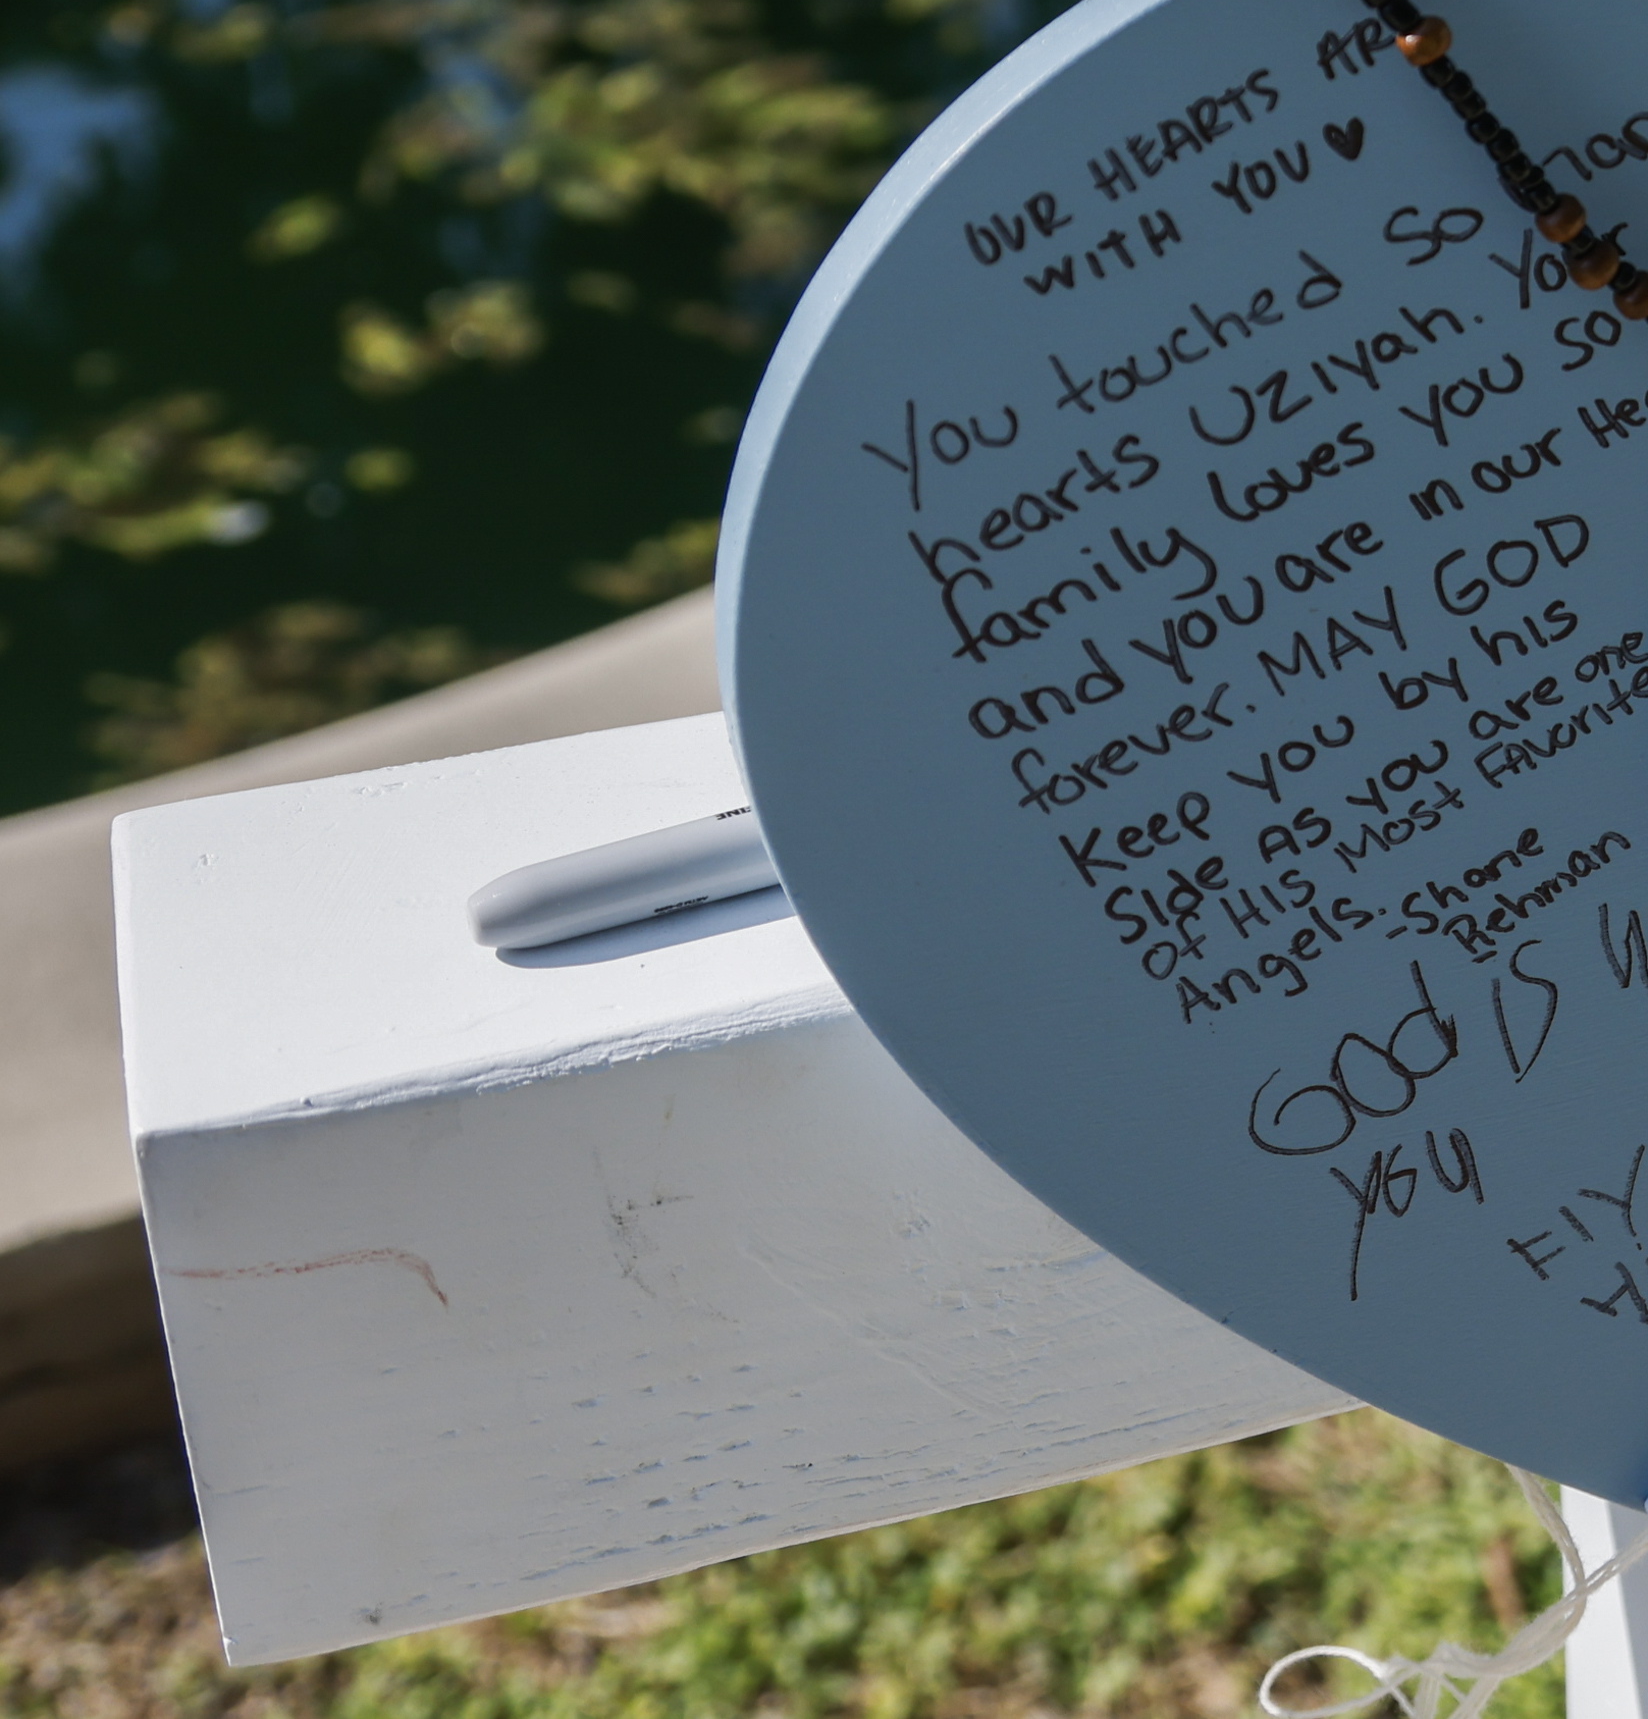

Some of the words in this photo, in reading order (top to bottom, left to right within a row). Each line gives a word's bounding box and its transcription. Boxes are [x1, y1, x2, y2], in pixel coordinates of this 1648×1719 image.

[963, 190, 1073, 266] OUR
[1087, 68, 1280, 201] HEARTS
[1022, 208, 1182, 296] WITH
[1210, 139, 1310, 215] YOU
[860, 398, 1019, 512] You
[1048, 249, 1343, 414] touched
[907, 433, 1161, 583] hearts
[1488, 222, 1629, 310] Yor
[941, 526, 1218, 662] family
[1206, 421, 1376, 523] loves
[967, 637, 1125, 740] and
[1274, 520, 1384, 593] are
[1470, 426, 1562, 494] our
[1010, 681, 1257, 816] forever.
[1256, 585, 1408, 698] MAY
[1433, 513, 1590, 616] GOD
[1057, 790, 1211, 888] Keep
[1377, 656, 1469, 711] by
[1467, 674, 1564, 741] are
